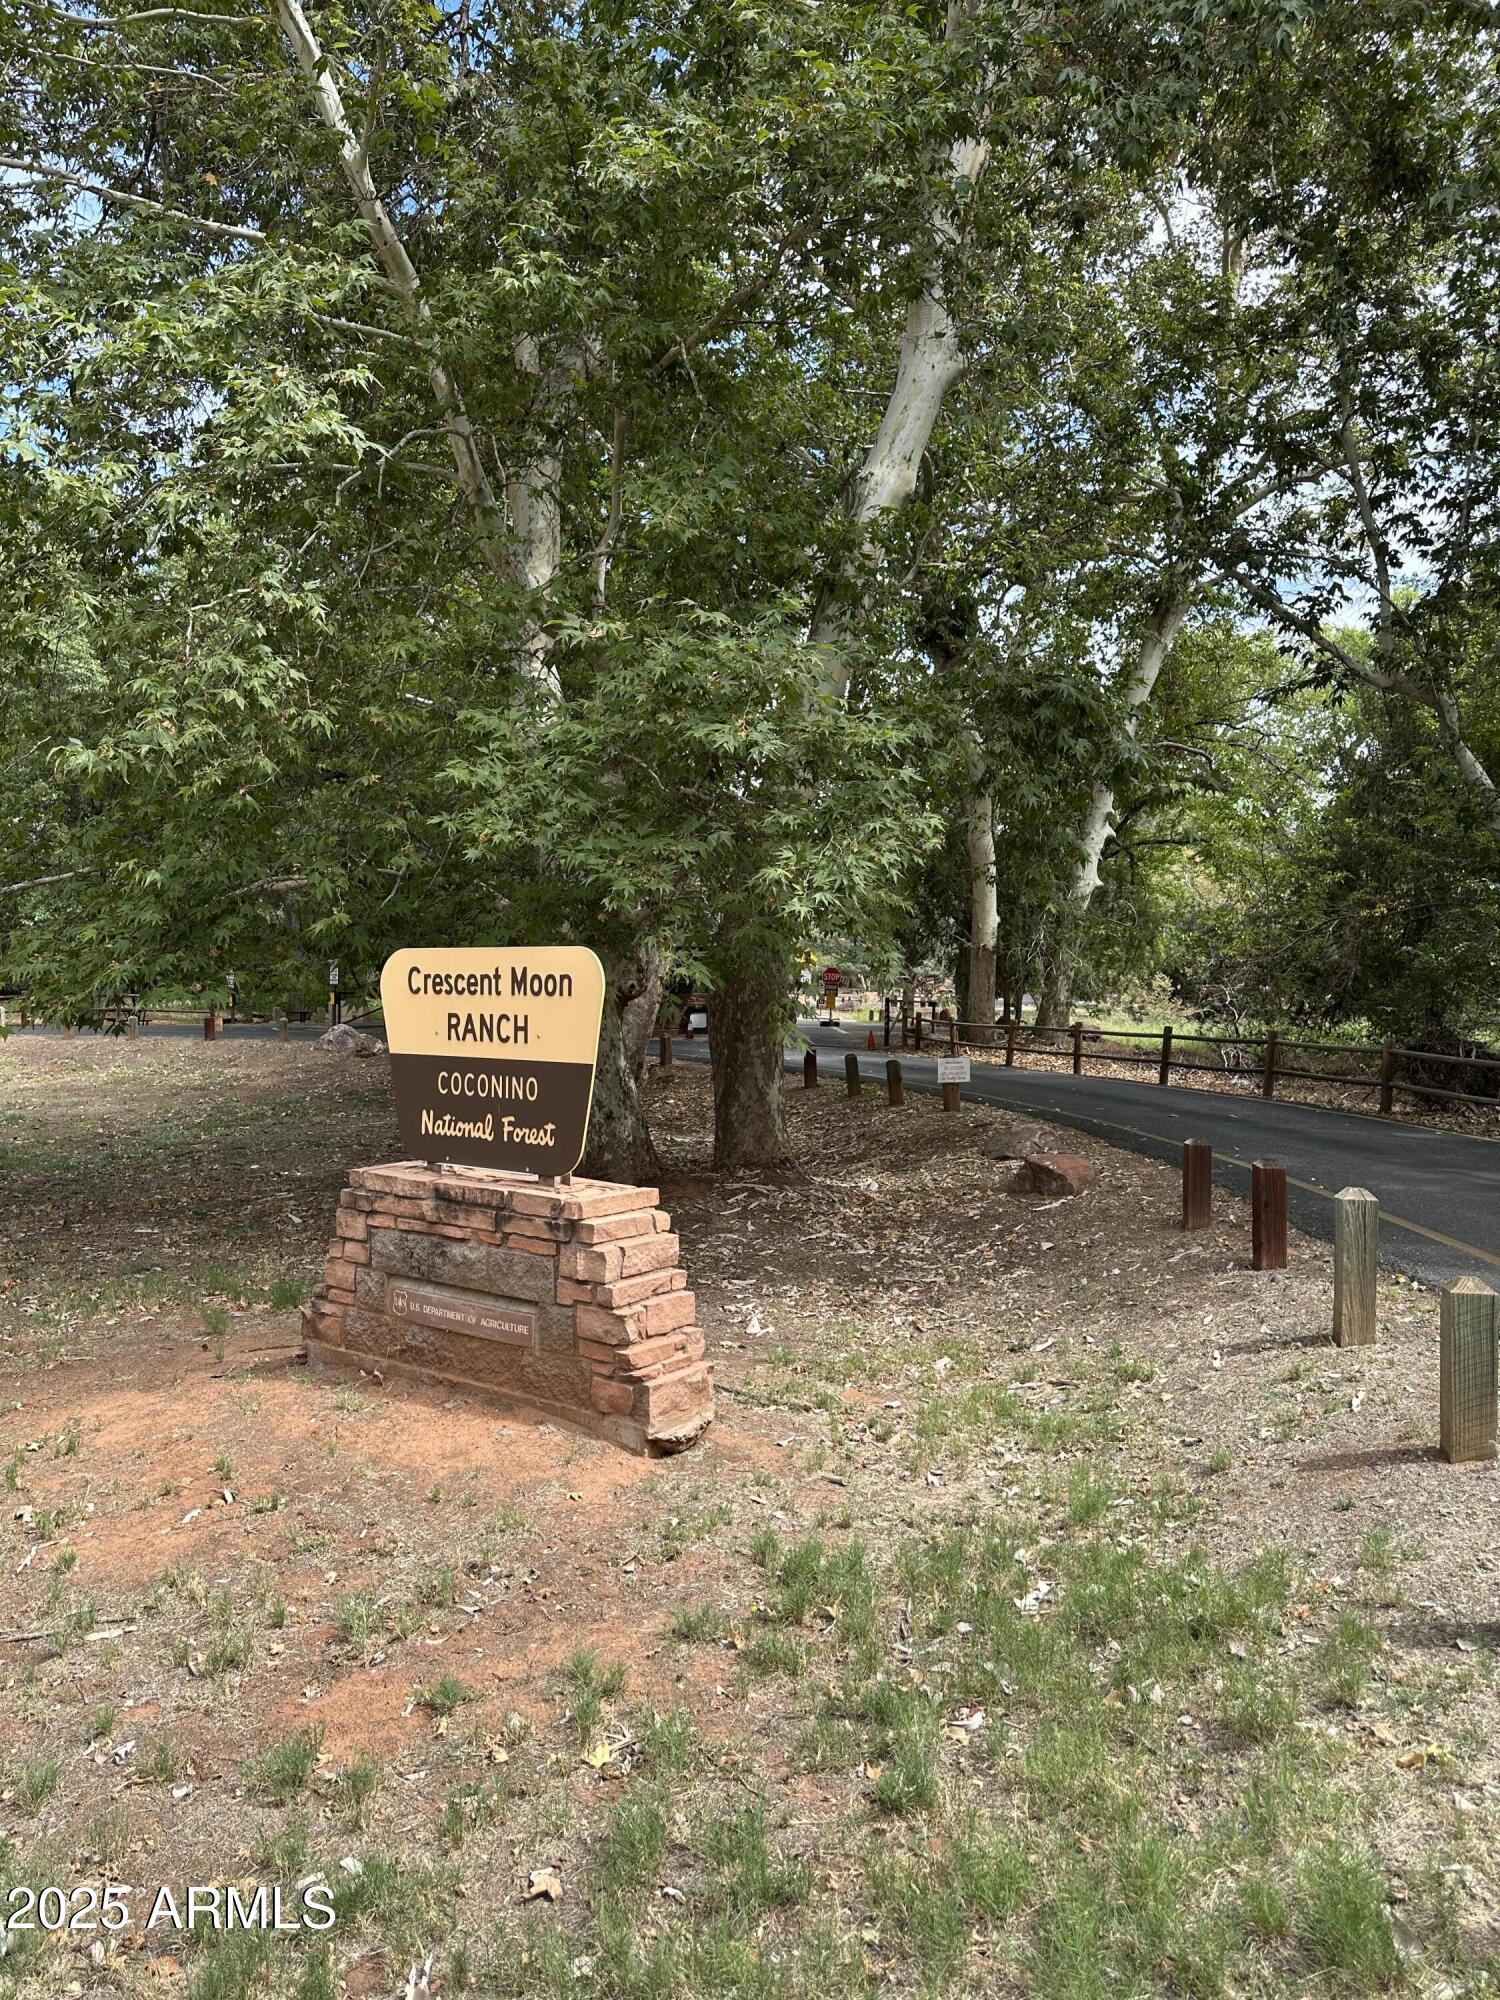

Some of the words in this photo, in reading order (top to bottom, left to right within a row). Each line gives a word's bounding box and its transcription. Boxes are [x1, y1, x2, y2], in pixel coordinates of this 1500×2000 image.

[408, 966, 501, 996] Crescent
[510, 966, 573, 997] Moon
[824, 972, 840, 981] STOP
[447, 1012, 529, 1044] RANCH
[437, 1071, 539, 1101] COCONINO
[421, 1109, 494, 1141] National
[501, 1115, 556, 1147] Forest
[409, 1301, 421, 1312] U.S.
[422, 1305, 465, 1322] DEPARTMENT
[468, 1315, 478, 1324] OF
[480, 1317, 530, 1335] AGRICULTURE
